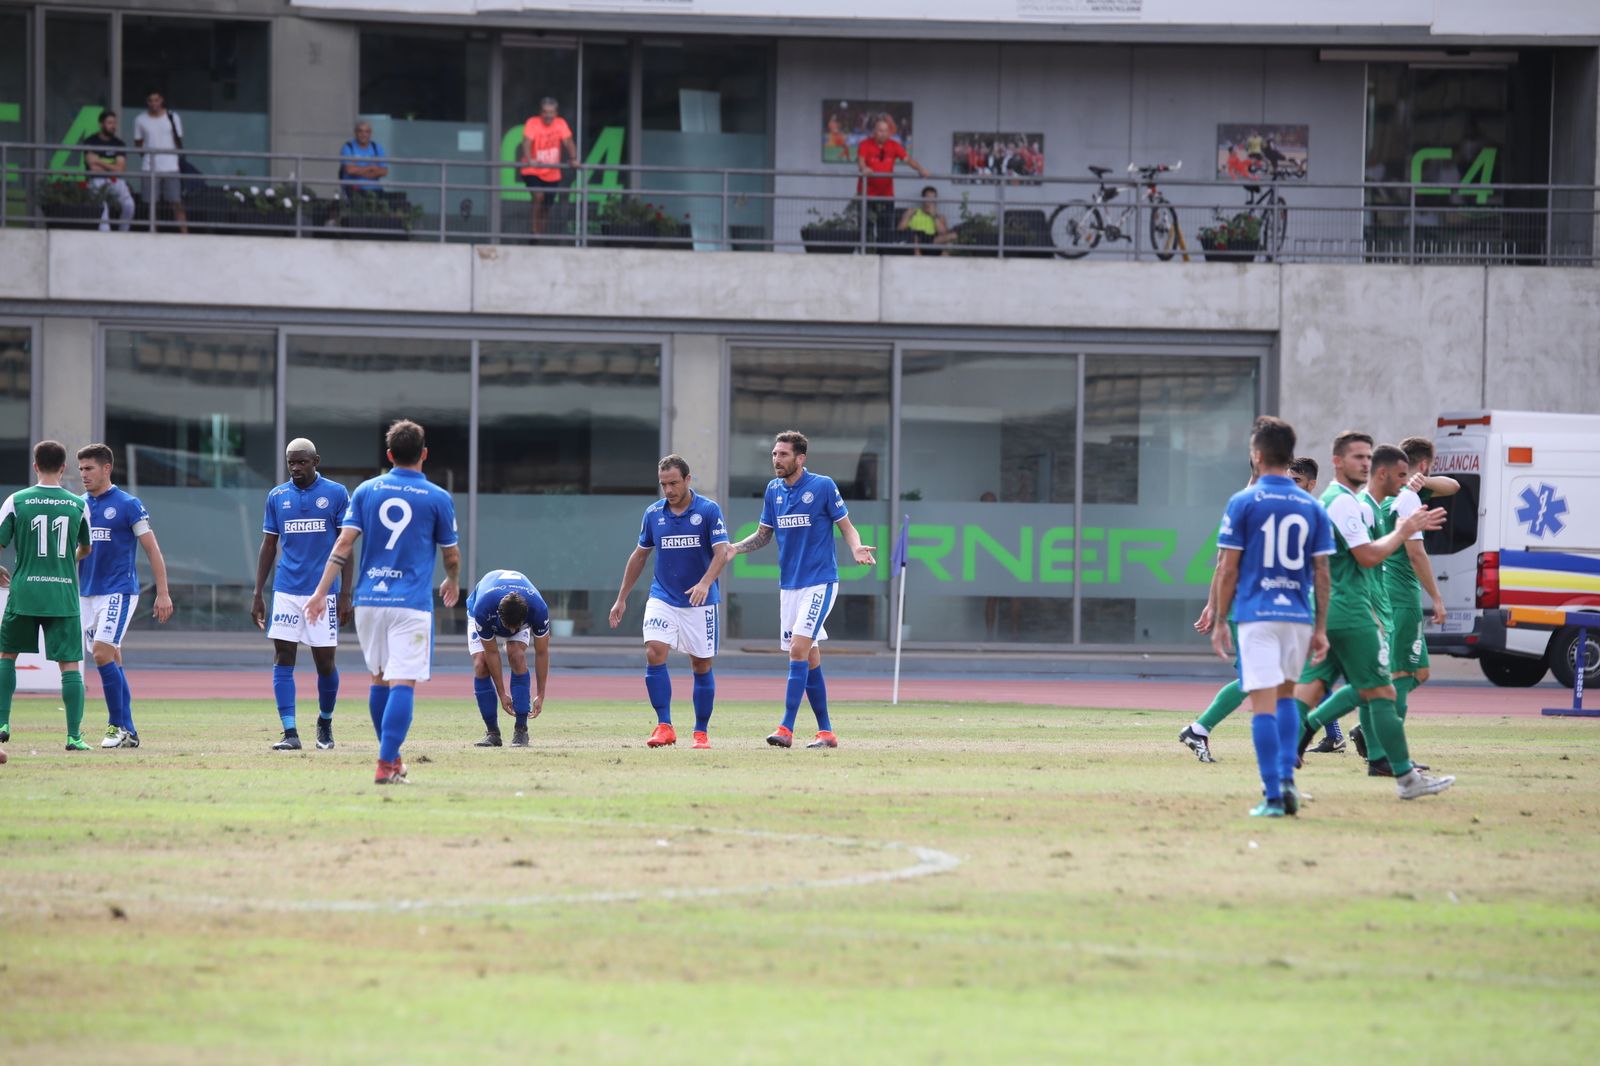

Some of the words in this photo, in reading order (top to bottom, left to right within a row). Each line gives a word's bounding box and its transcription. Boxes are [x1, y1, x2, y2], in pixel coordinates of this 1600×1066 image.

[1410, 147, 1497, 205] C4
[1432, 455, 1480, 473] BULANCIA
[31, 514, 69, 558] 11
[91, 529, 111, 540] ABE
[284, 521, 326, 532] RANABE
[379, 497, 413, 550] 9
[777, 516, 811, 527] RANABE
[661, 537, 700, 547] RANABE
[1260, 513, 1310, 570] 10
[106, 594, 120, 624] XEREZ
[327, 597, 337, 630] XEREZ
[806, 592, 824, 623] XEREZ
[705, 609, 714, 641] XEREZ
